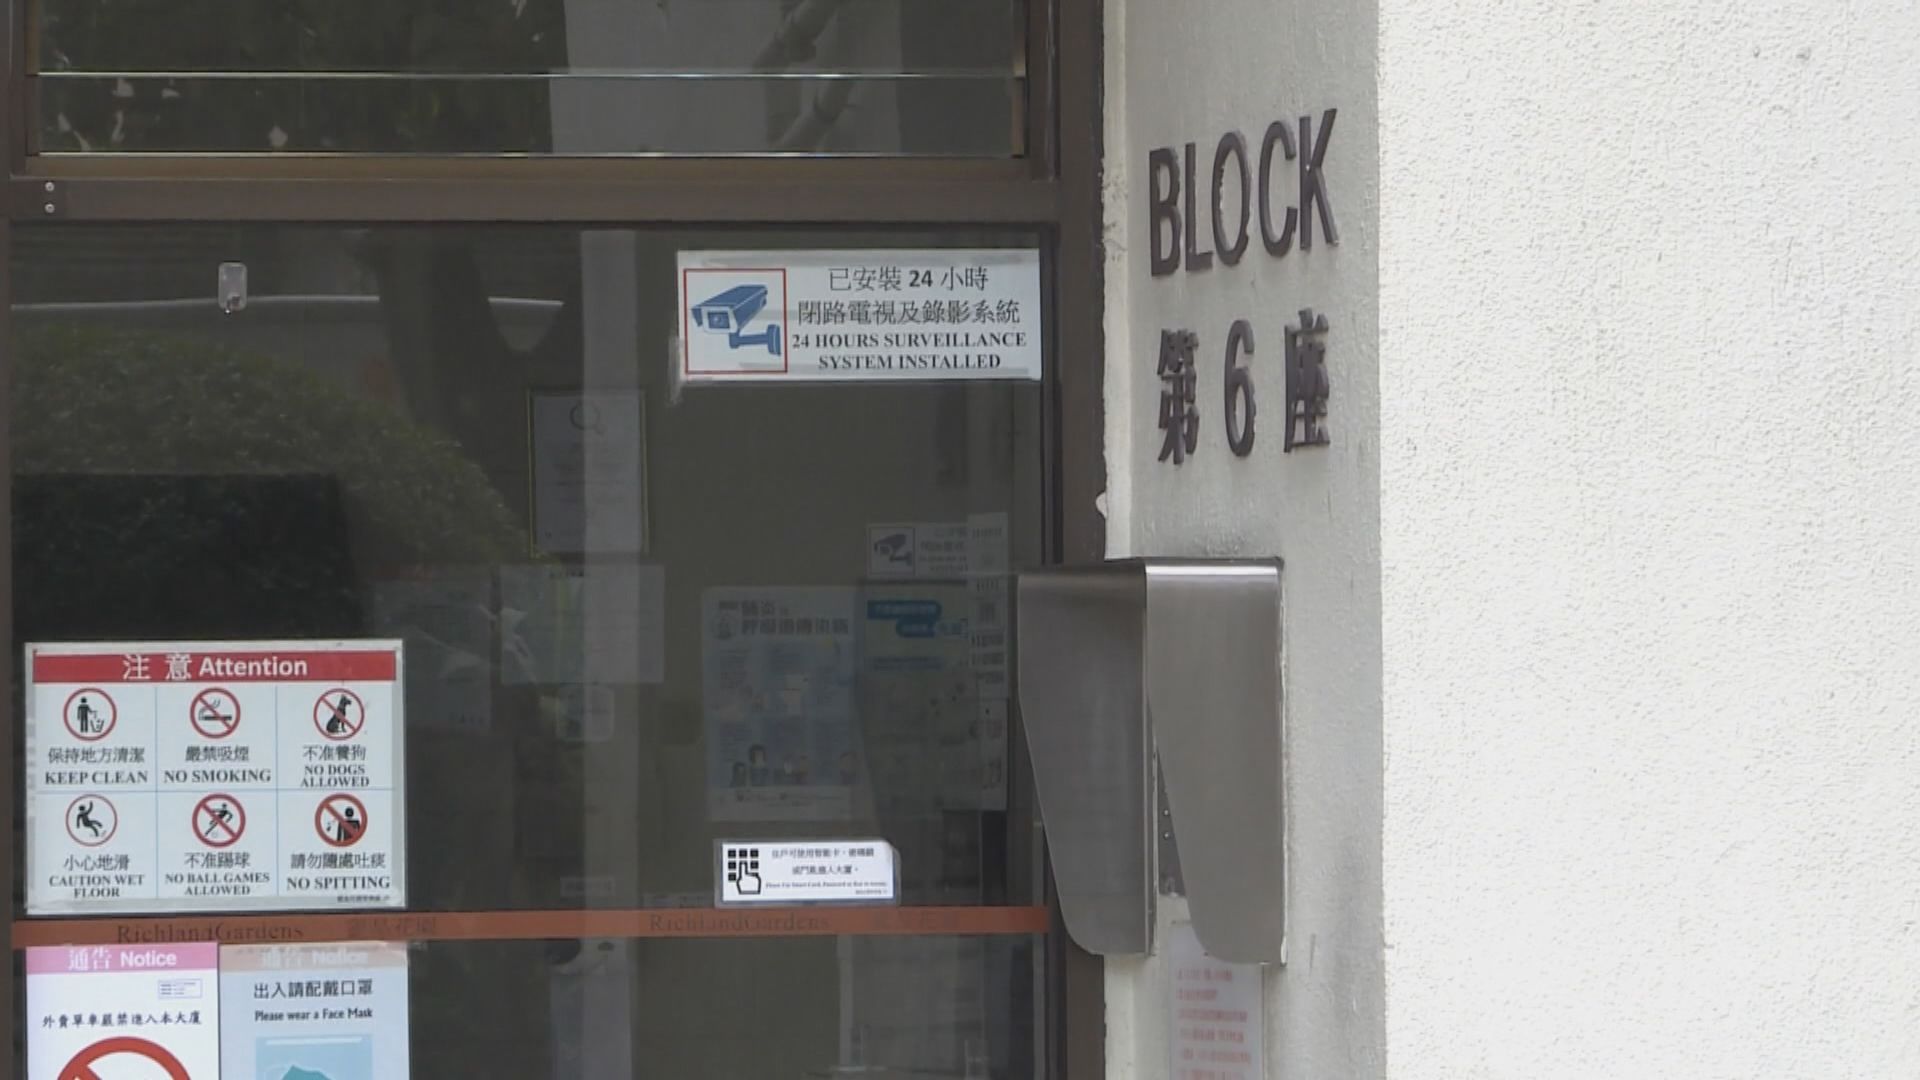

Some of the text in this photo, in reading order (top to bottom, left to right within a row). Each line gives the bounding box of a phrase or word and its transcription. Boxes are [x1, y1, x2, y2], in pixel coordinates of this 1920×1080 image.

[1150, 108, 1340, 277] BLOCK
[829, 266, 989, 291] 已安裝 24 小時
[798, 299, 1021, 325] 閉路電視及錄影系統
[792, 332, 1026, 348] 24 HOURS SURVEILLANCE
[818, 354, 1000, 370] SYSTEM INSTALLED
[1224, 319, 1256, 458] 6
[200, 656, 308, 676] Attention
[48, 746, 145, 764] 保持地方清潔
[45, 770, 148, 785] KEEP CLEAN
[164, 769, 271, 783] NO SMOKING
[304, 764, 366, 776] NO DOGS
[301, 776, 370, 788] ALLOWED
[64, 854, 130, 871] 小心地滑
[49, 874, 145, 887] CAUTION WET
[165, 872, 270, 884] NO BALL GAMES
[287, 876, 390, 889] NO SPITTING
[74, 888, 120, 898] FLOOR
[184, 886, 251, 896] ALLOWED
[68, 946, 177, 971] 通告 Notice
[253, 977, 374, 999] 出入請配戴口罩
[255, 1007, 373, 1021] Please wear a Face Mask
